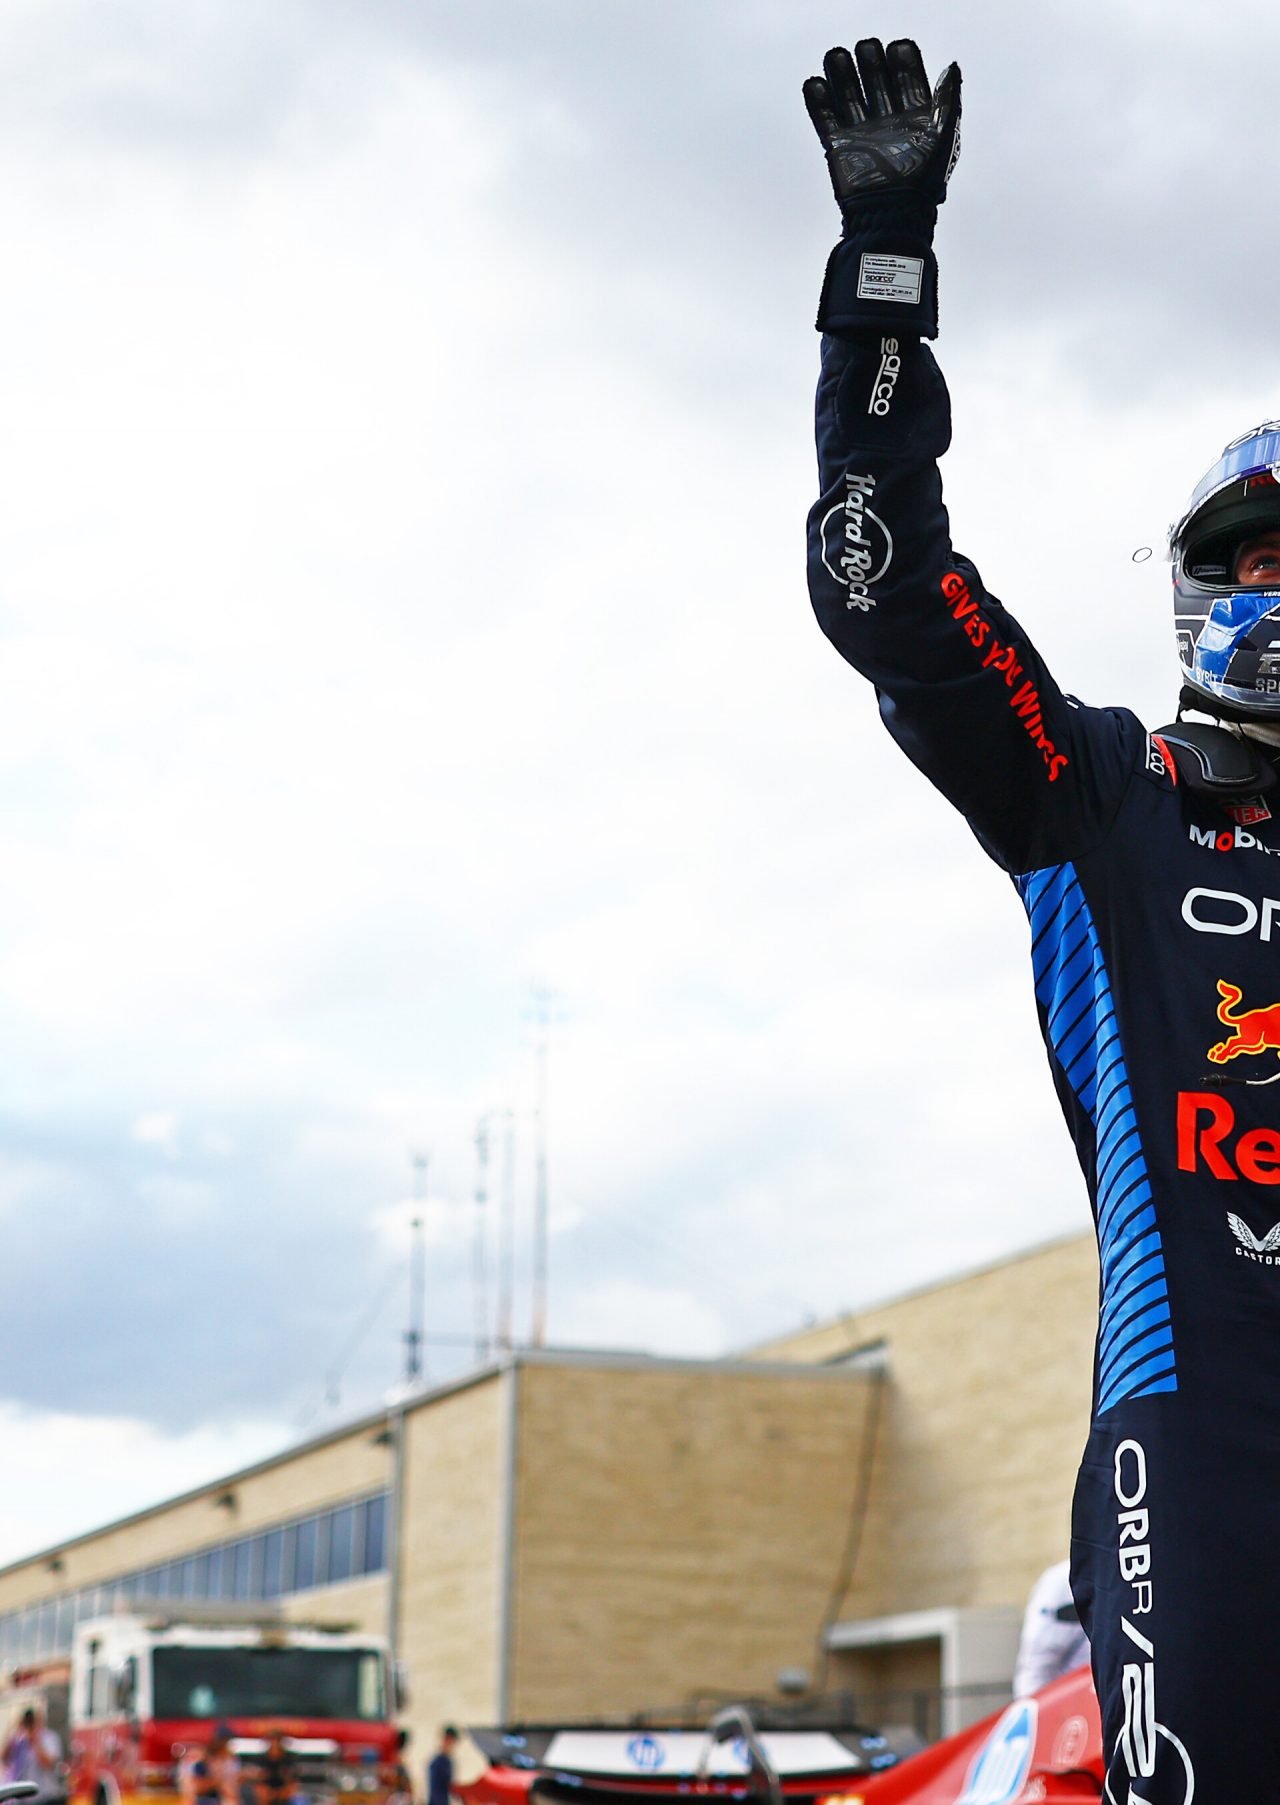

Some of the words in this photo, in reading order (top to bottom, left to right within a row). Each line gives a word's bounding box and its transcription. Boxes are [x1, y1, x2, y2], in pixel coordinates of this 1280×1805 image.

[868, 337, 900, 416] sarco
[845, 473, 876, 546] Hard
[841, 547, 877, 612] Rock
[940, 572, 990, 647] GIVES
